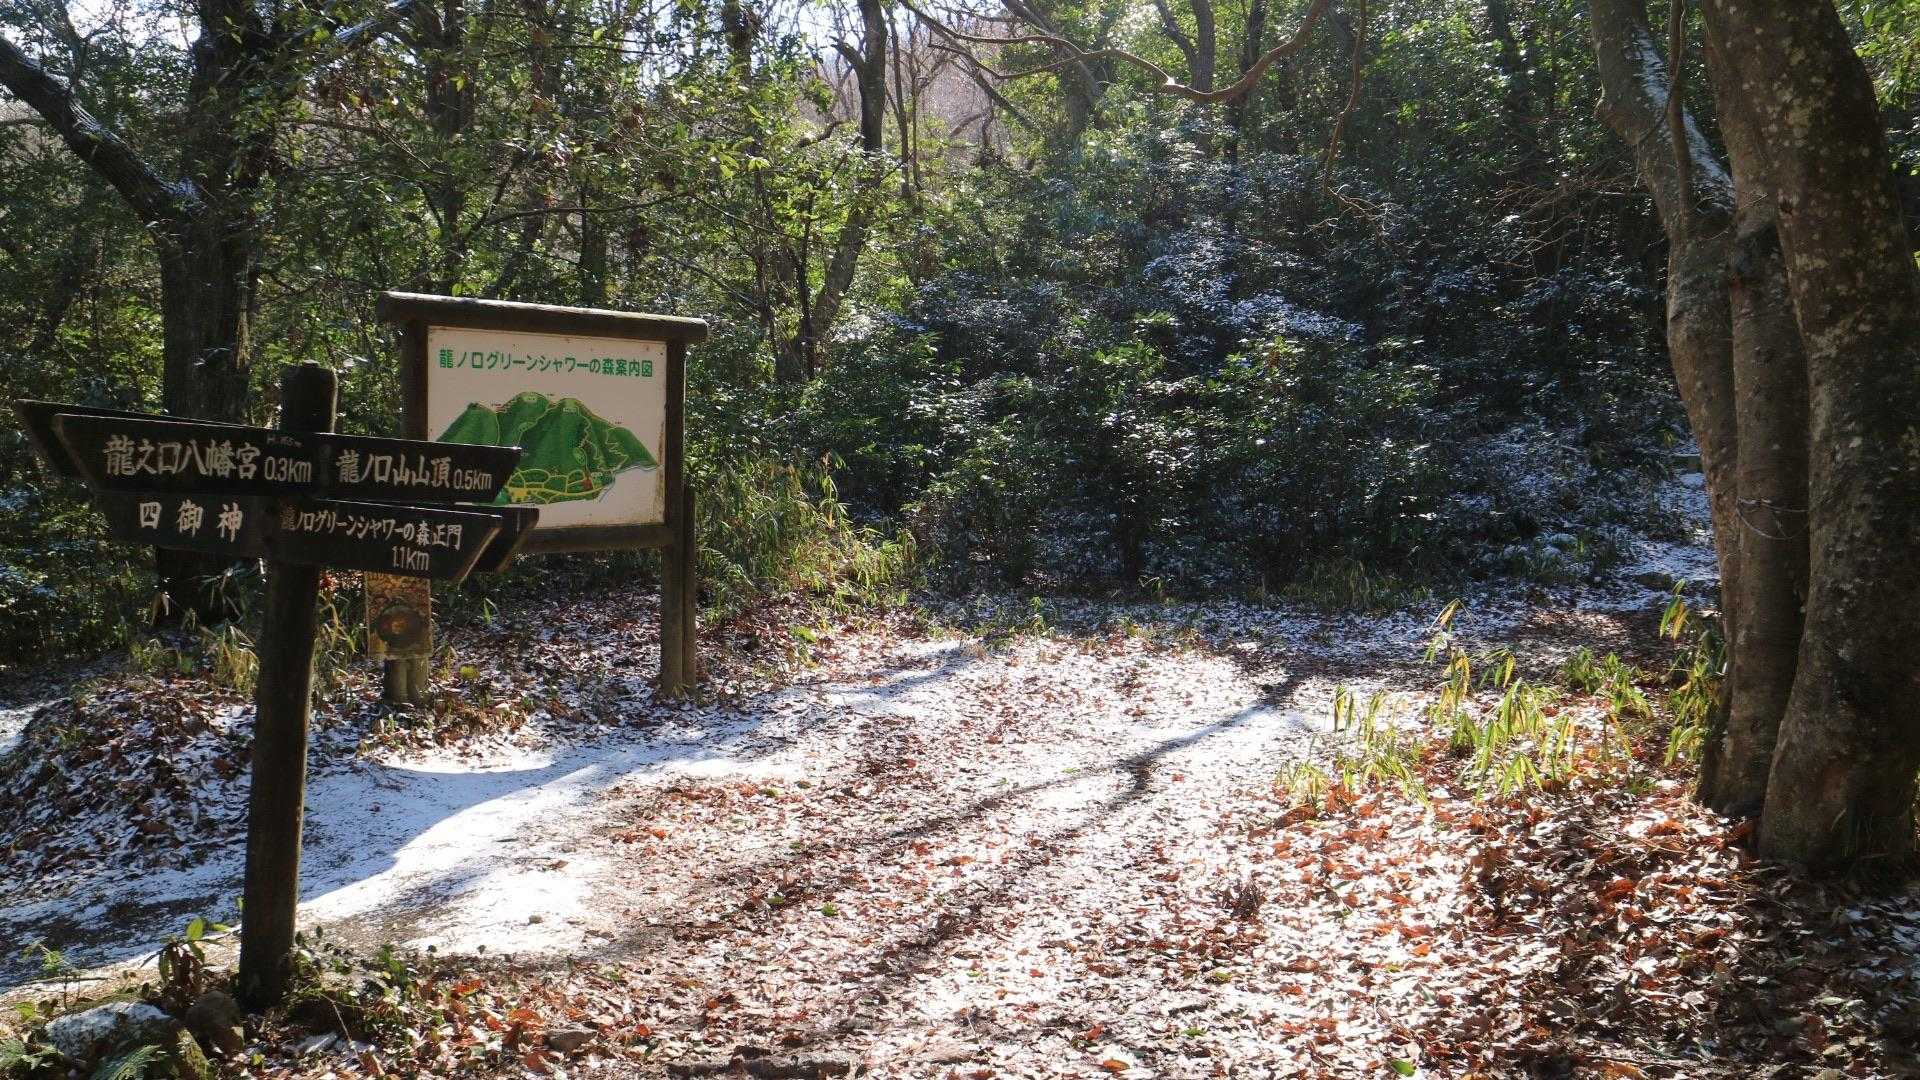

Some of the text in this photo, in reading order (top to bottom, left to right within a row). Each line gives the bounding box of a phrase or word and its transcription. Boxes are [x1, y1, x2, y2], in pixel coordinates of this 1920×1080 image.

[103, 434, 312, 483] 龍之口八幡宮 0.3km
[453, 469, 493, 491] 0.5km
